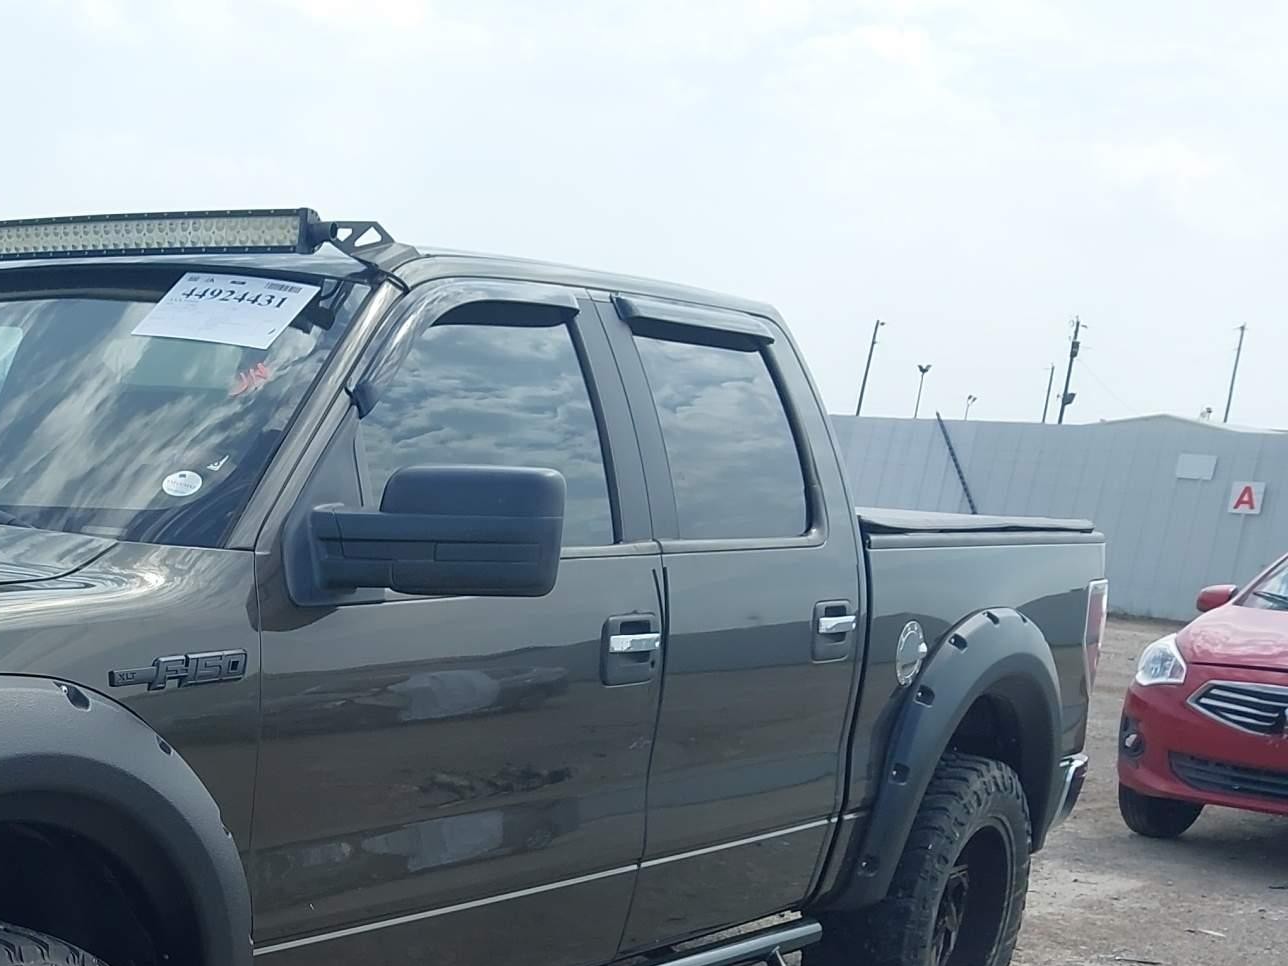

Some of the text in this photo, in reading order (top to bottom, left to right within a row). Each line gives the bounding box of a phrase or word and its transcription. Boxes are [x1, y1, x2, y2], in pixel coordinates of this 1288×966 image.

[182, 286, 287, 309] 44924431
[1233, 486, 1255, 510] A
[118, 649, 247, 691] XLT F-150
